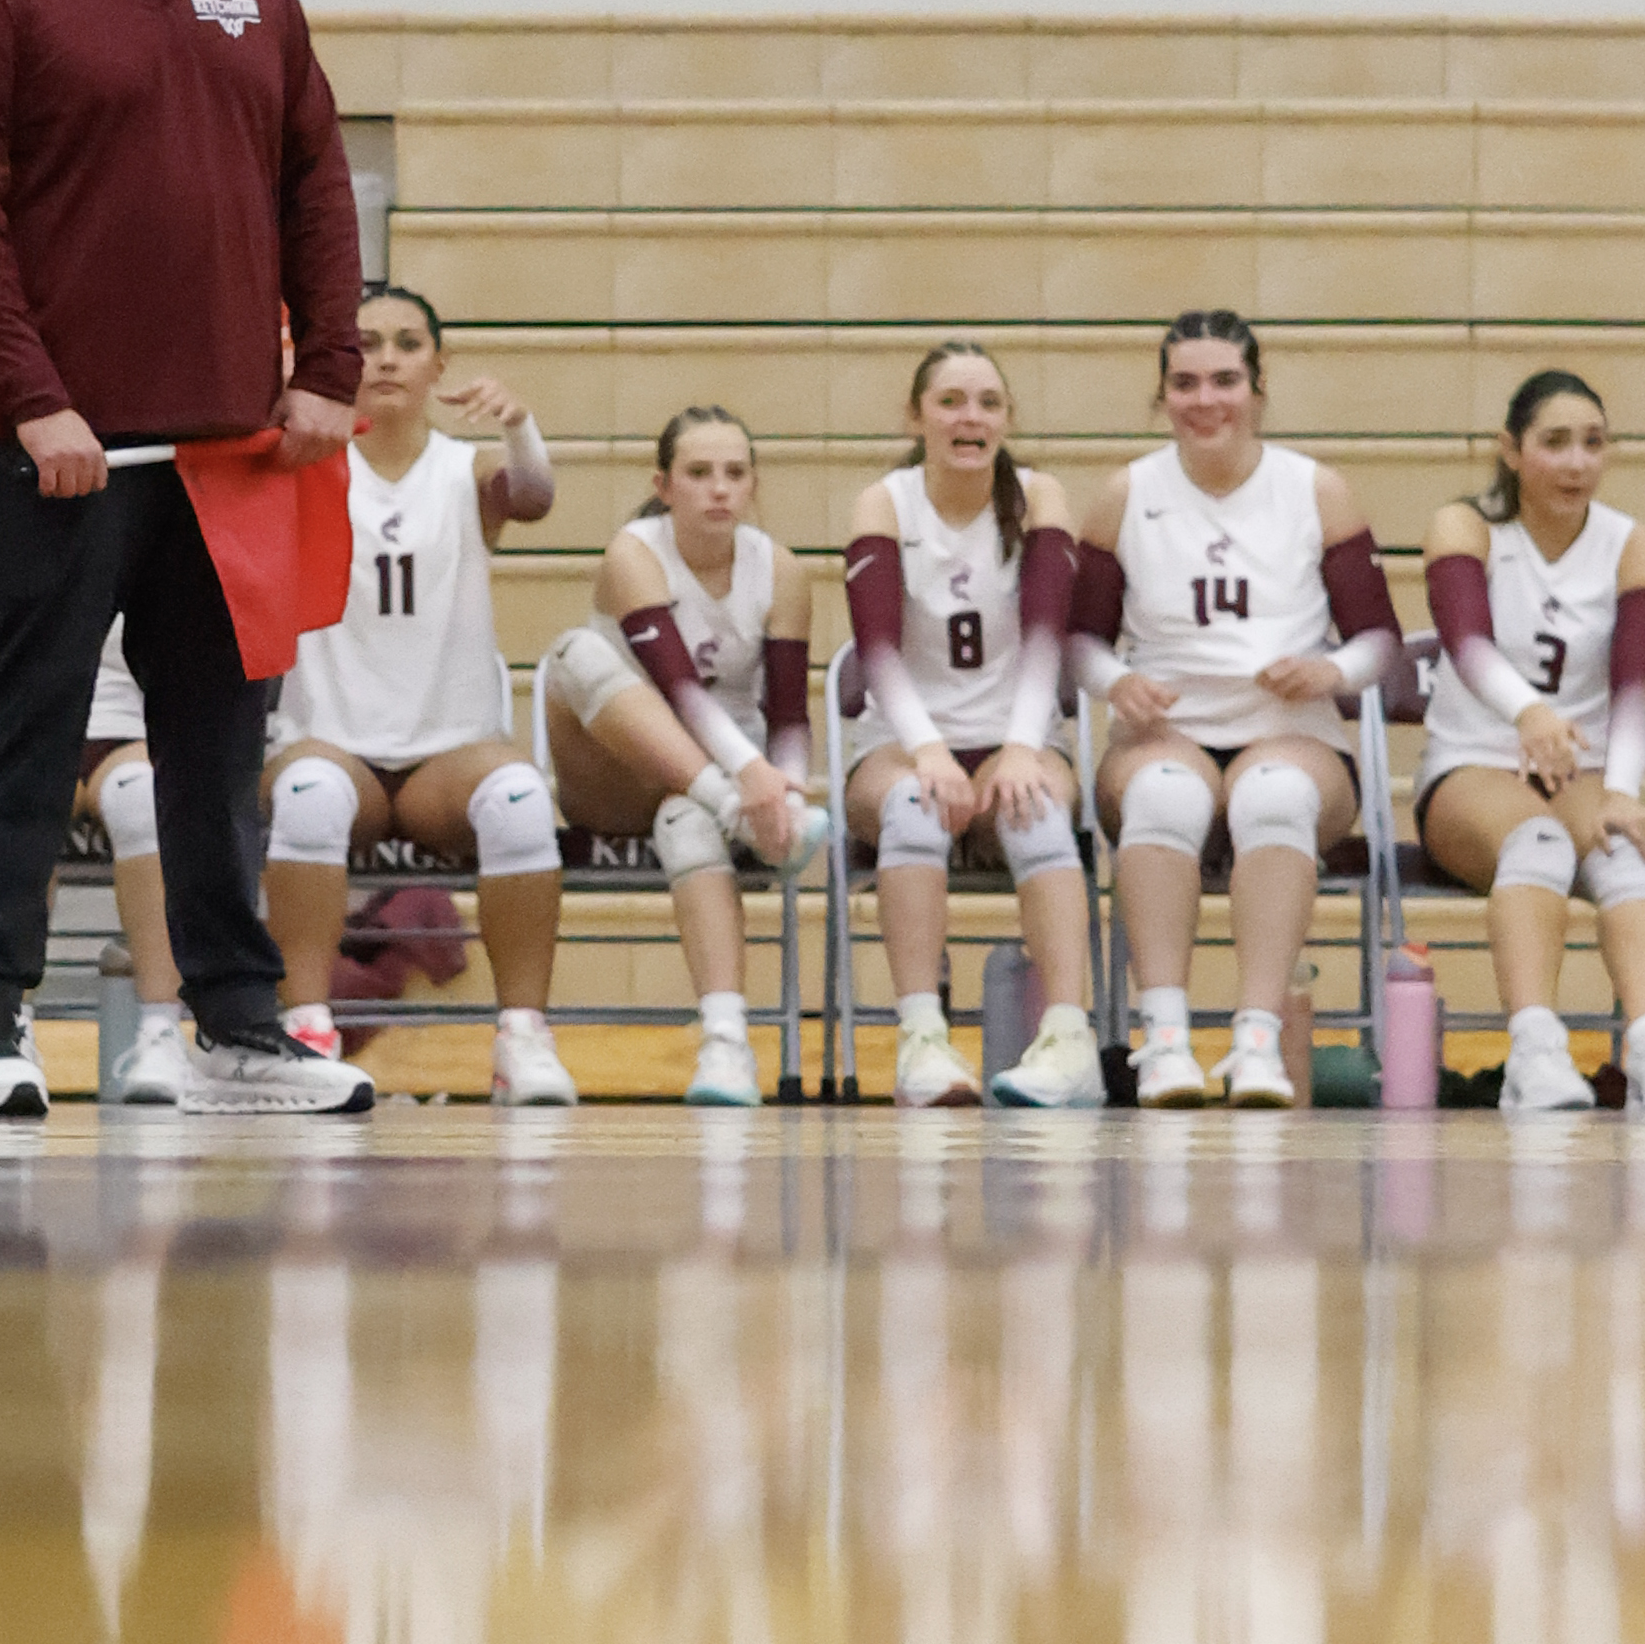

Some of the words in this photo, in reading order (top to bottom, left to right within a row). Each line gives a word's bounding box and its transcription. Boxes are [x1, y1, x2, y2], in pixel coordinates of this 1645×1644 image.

[374, 551, 415, 616] 11
[1190, 576, 1248, 628] 14
[948, 610, 983, 670] 8
[1530, 631, 1567, 695] 3
